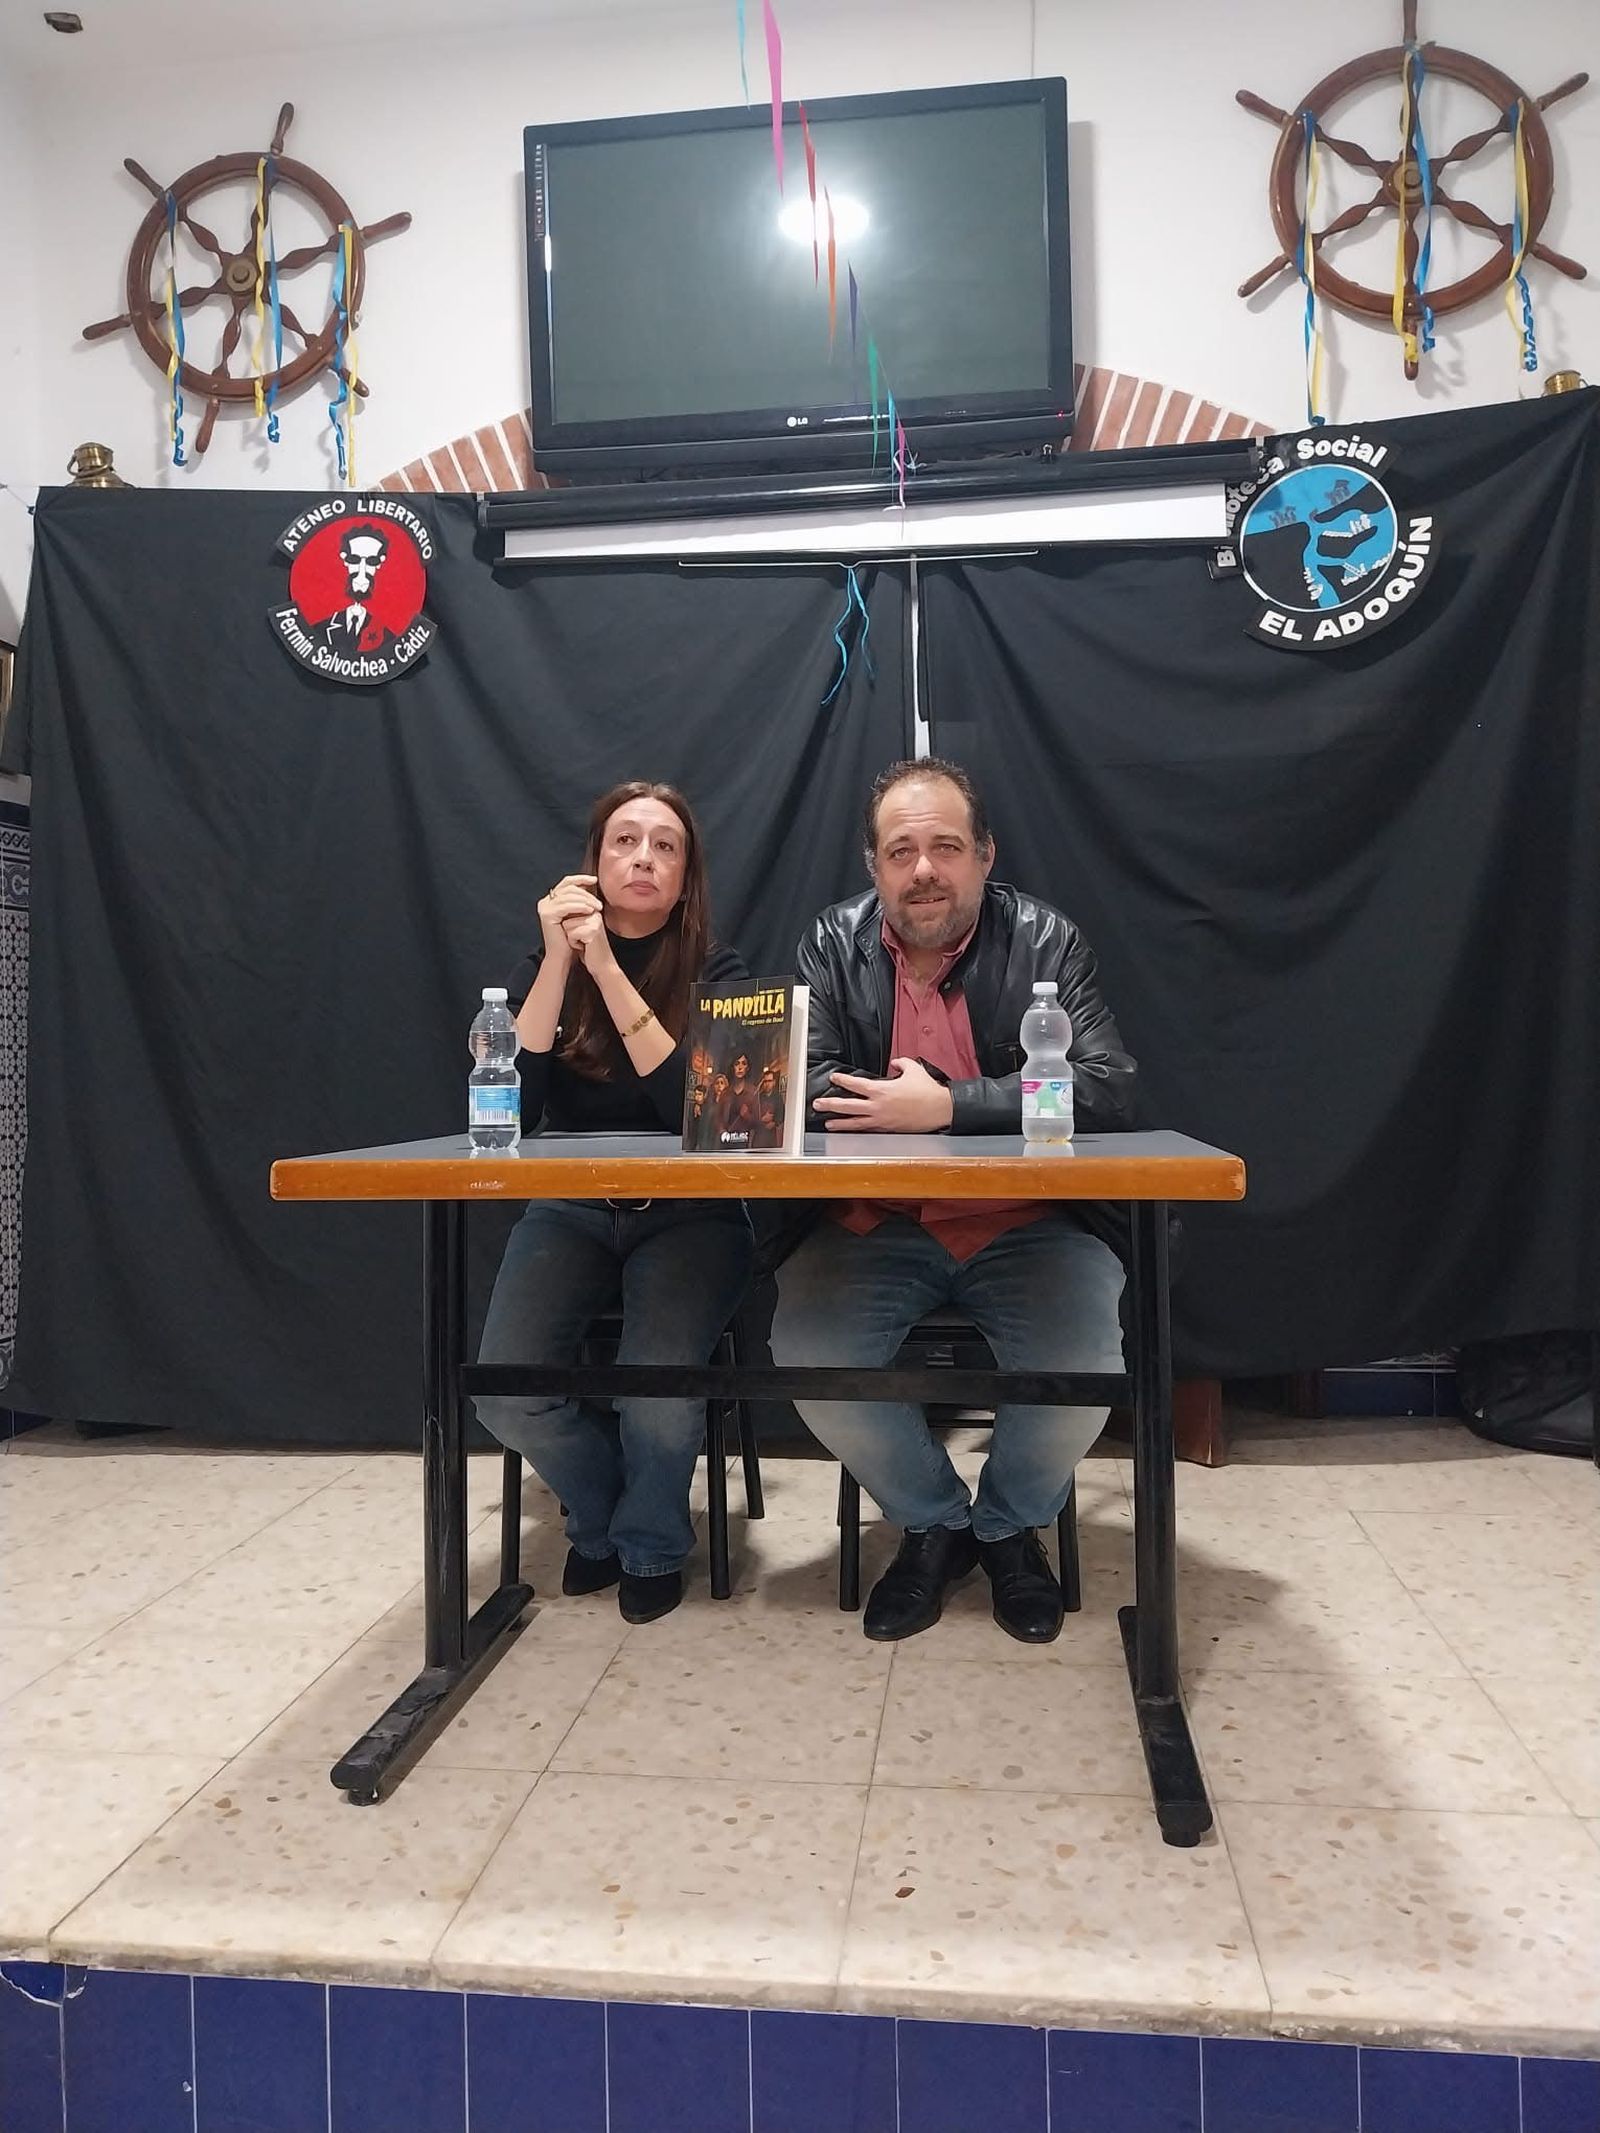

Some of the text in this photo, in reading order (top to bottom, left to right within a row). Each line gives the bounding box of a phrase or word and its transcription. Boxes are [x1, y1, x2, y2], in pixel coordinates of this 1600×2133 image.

[1297, 435, 1388, 468] Social
[283, 499, 433, 560] ATENEO LIBERTARIO
[1259, 516, 1433, 642] EL ADOQUÍN
[276, 607, 431, 677] Fermín Salvochea Cádiz
[700, 993, 785, 1019] LA PANDILLA
